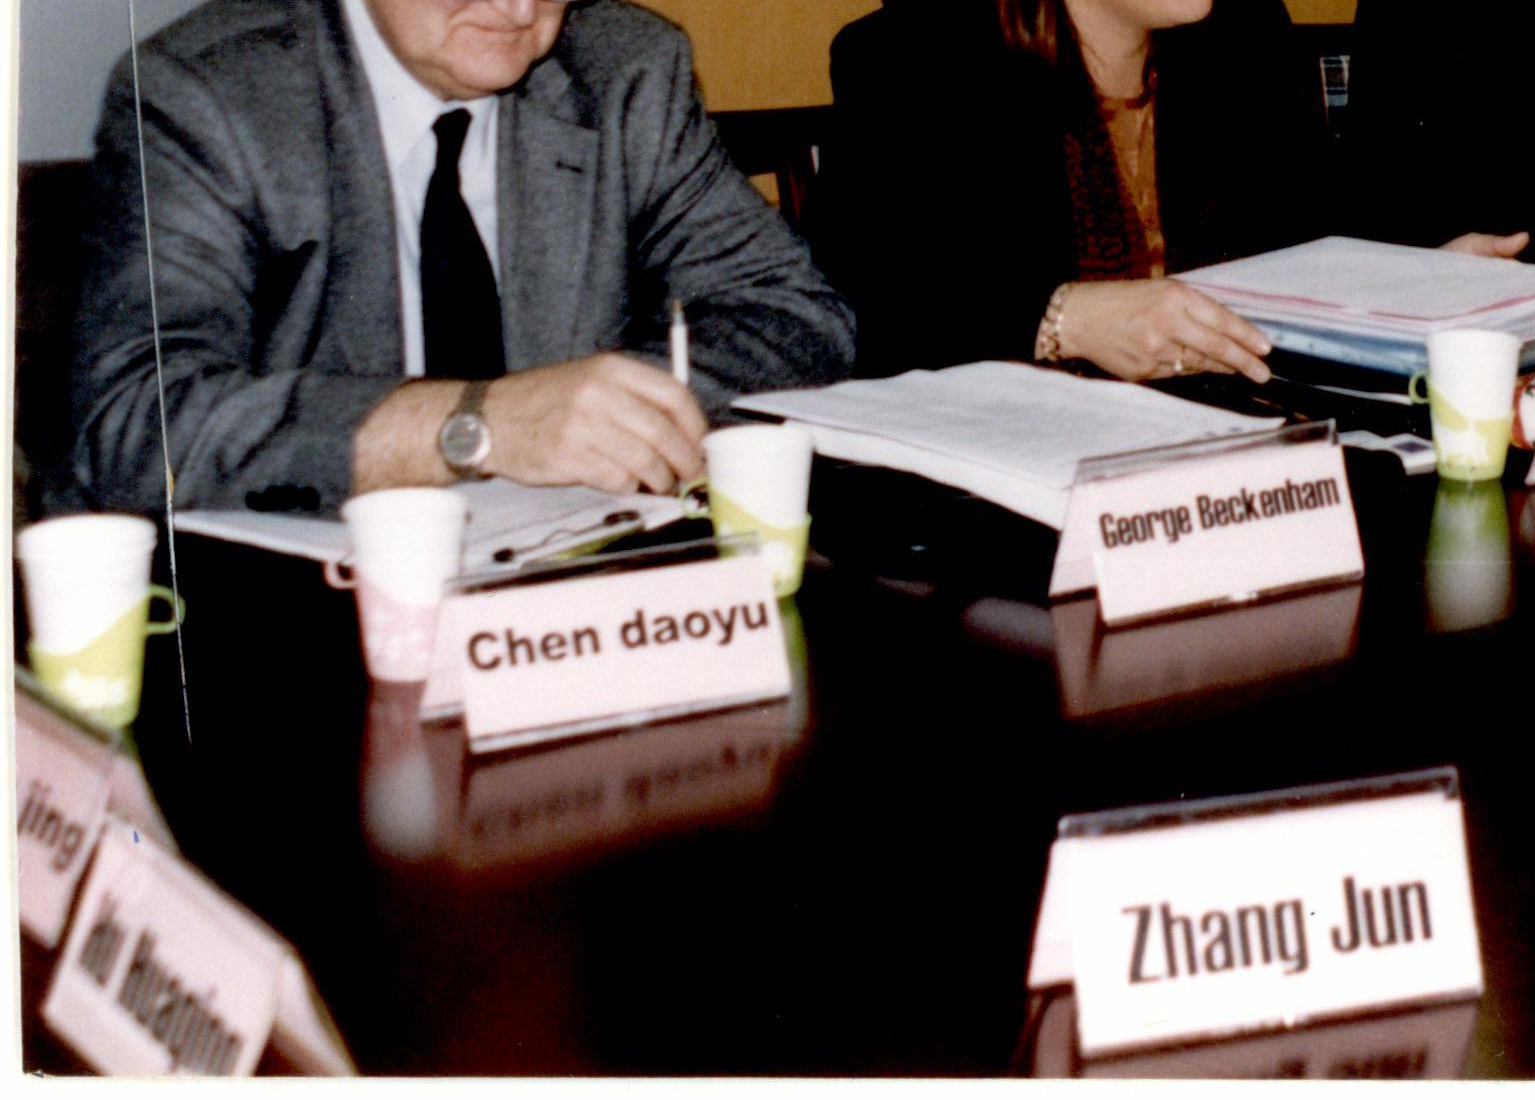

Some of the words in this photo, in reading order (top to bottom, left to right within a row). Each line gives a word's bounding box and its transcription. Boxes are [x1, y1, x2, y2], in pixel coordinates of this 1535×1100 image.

[1098, 503, 1193, 550] George
[1196, 477, 1341, 531] Beckenham
[466, 627, 602, 672] Chen
[619, 601, 770, 649] daoyu
[1121, 898, 1310, 985] Zhang
[1330, 874, 1434, 954] Jun
